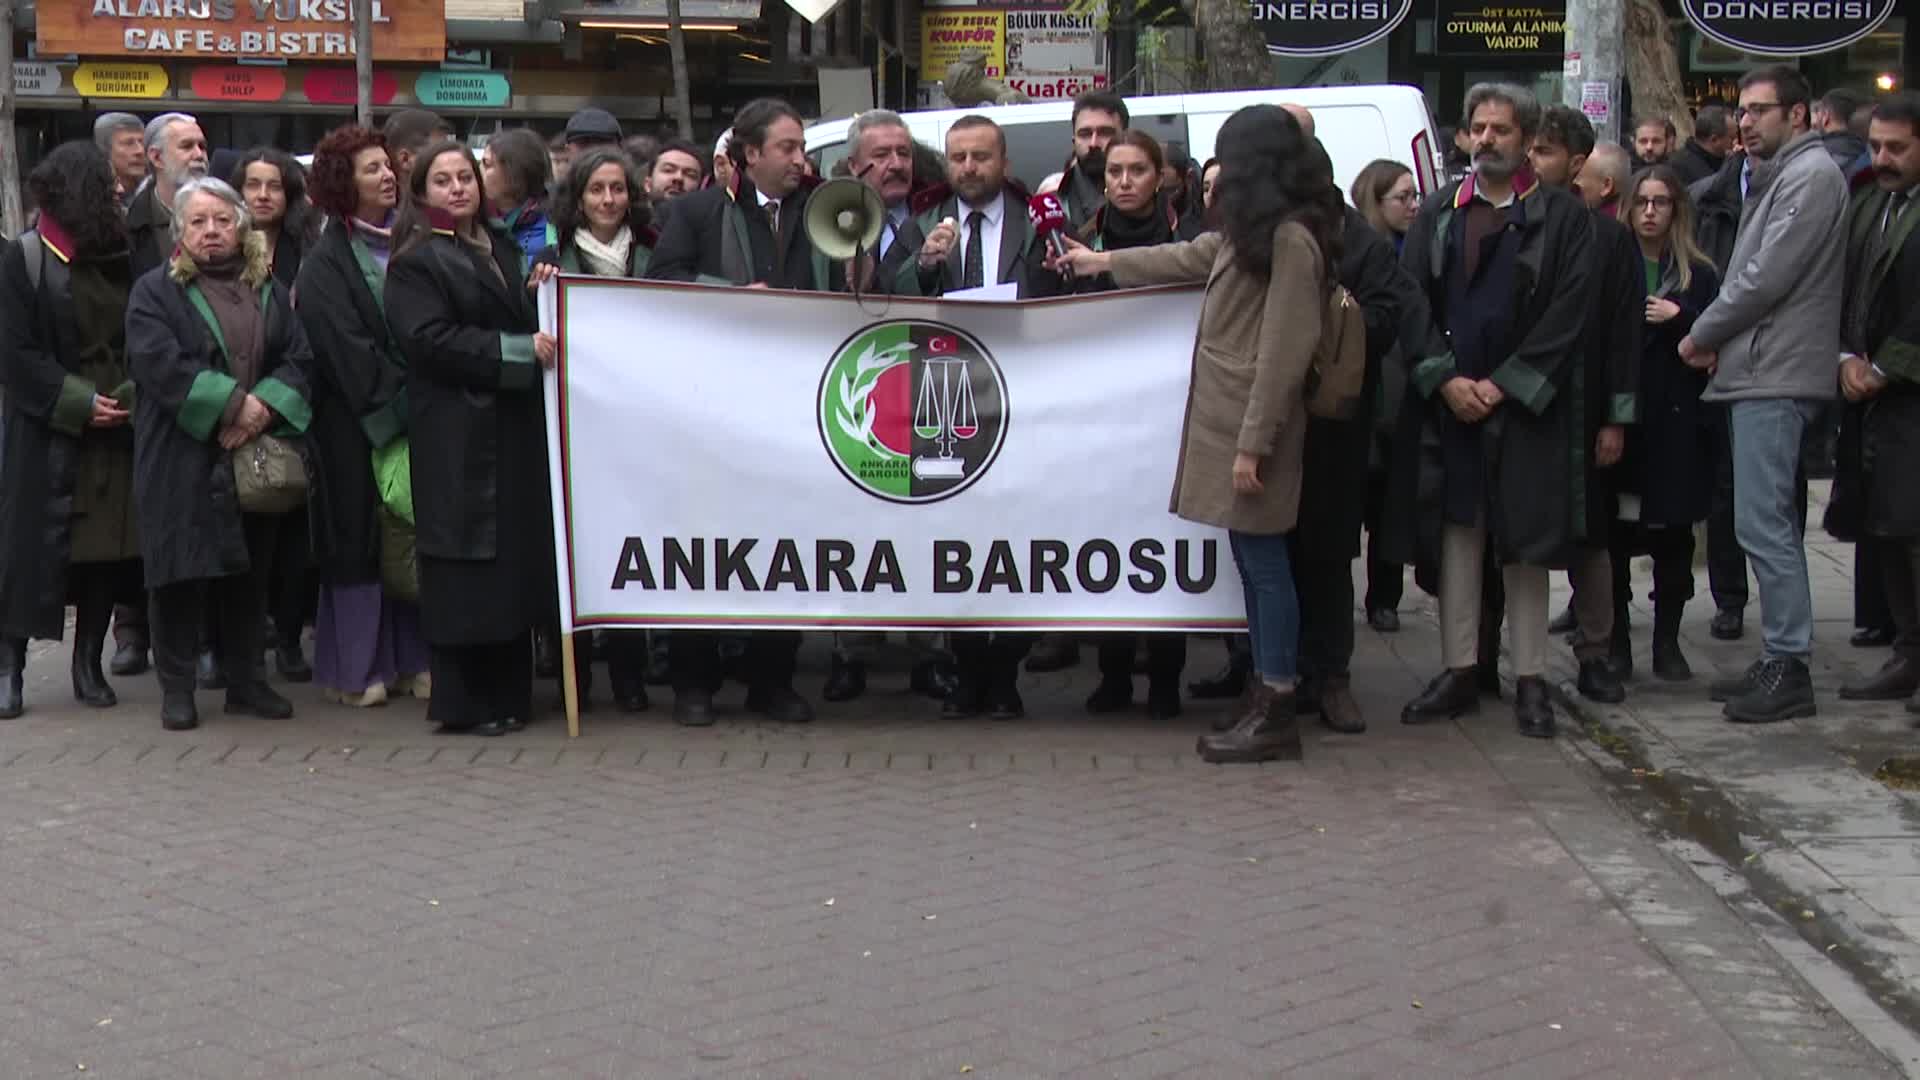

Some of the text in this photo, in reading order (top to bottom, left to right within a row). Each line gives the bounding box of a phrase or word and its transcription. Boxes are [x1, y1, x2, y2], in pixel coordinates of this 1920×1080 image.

[1507, 8, 1544, 18] KATTA
[1007, 12, 1047, 29] BÖLÜK
[1447, 21, 1568, 33] OTURMA ALANIM
[124, 27, 357, 54] CAFE&BİSTR
[929, 27, 995, 43] KUAFÖR
[1485, 36, 1540, 49] VARDIR
[92, 70, 150, 81] HAMBURGER
[436, 91, 488, 102] DONDURMA
[860, 460, 909, 469] ANKARA
[860, 470, 909, 479] BAROSU
[611, 535, 1218, 594] ANKARA BAROSU
